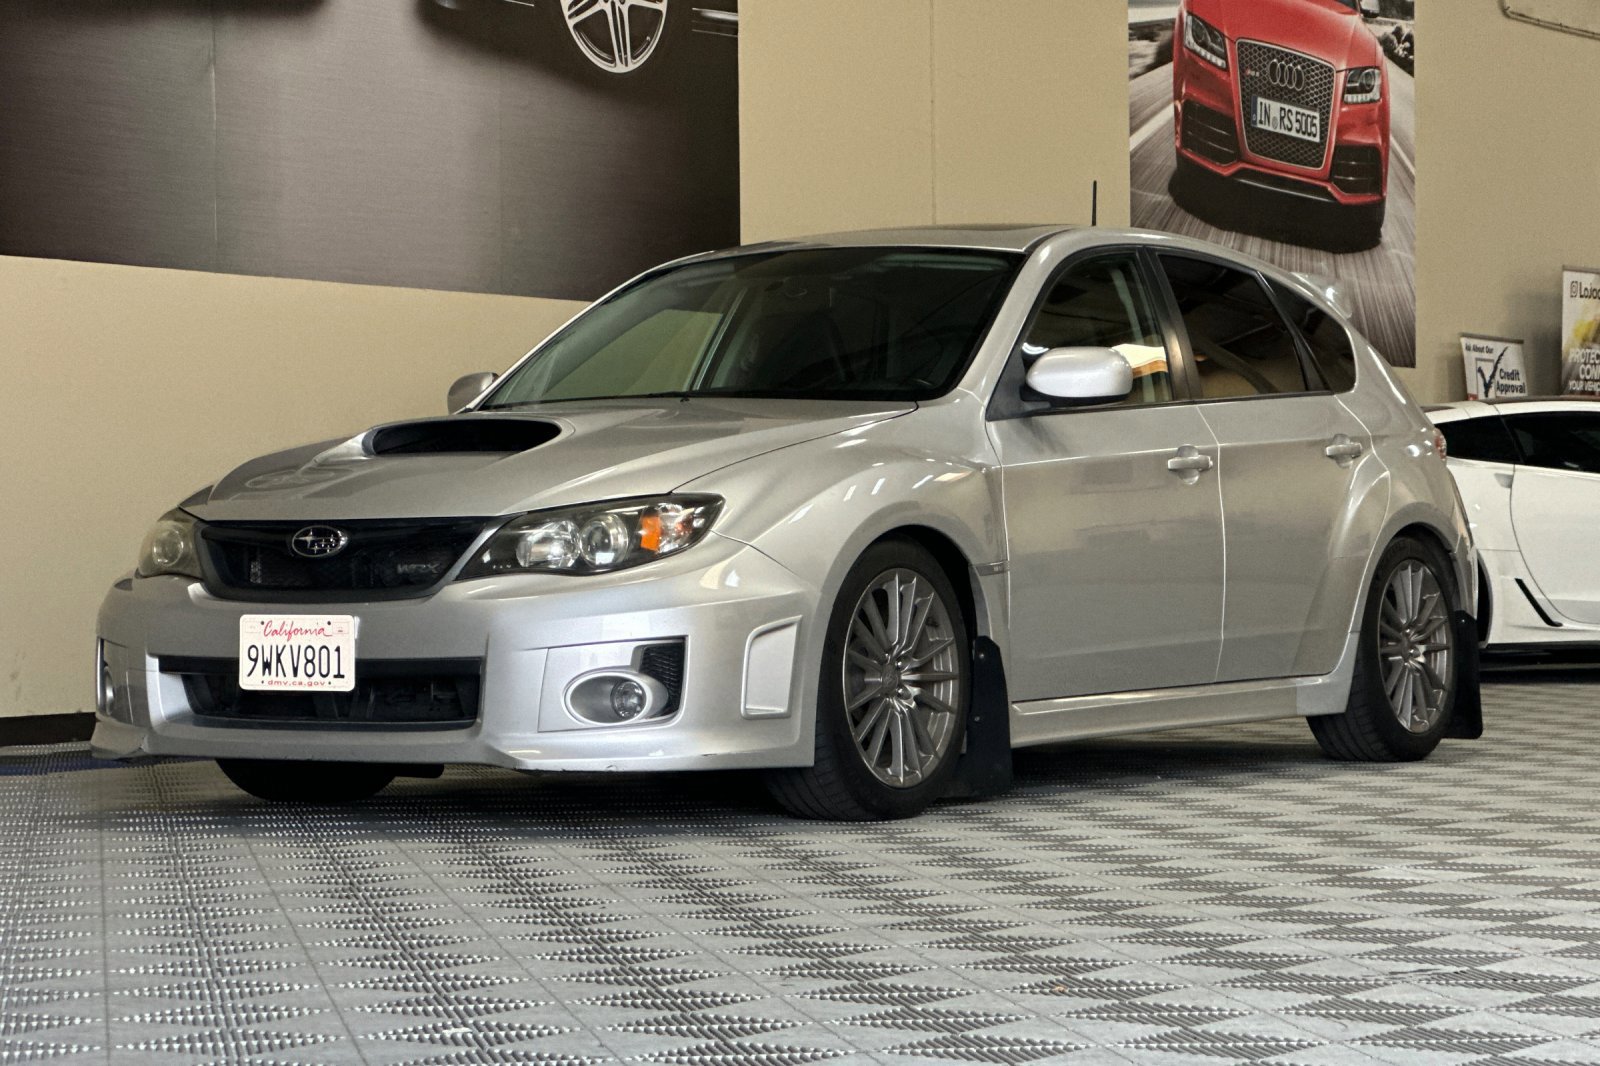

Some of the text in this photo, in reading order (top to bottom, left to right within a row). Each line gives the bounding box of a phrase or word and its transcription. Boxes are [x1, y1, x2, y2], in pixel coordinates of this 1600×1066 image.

[1259, 101, 1318, 138] IN RS 5005
[1499, 368, 1520, 381] Credit
[1496, 380, 1526, 395] Approval
[263, 620, 333, 642] California
[246, 644, 346, 679] 9WKV801
[267, 679, 326, 688] dmv.ca.gov
